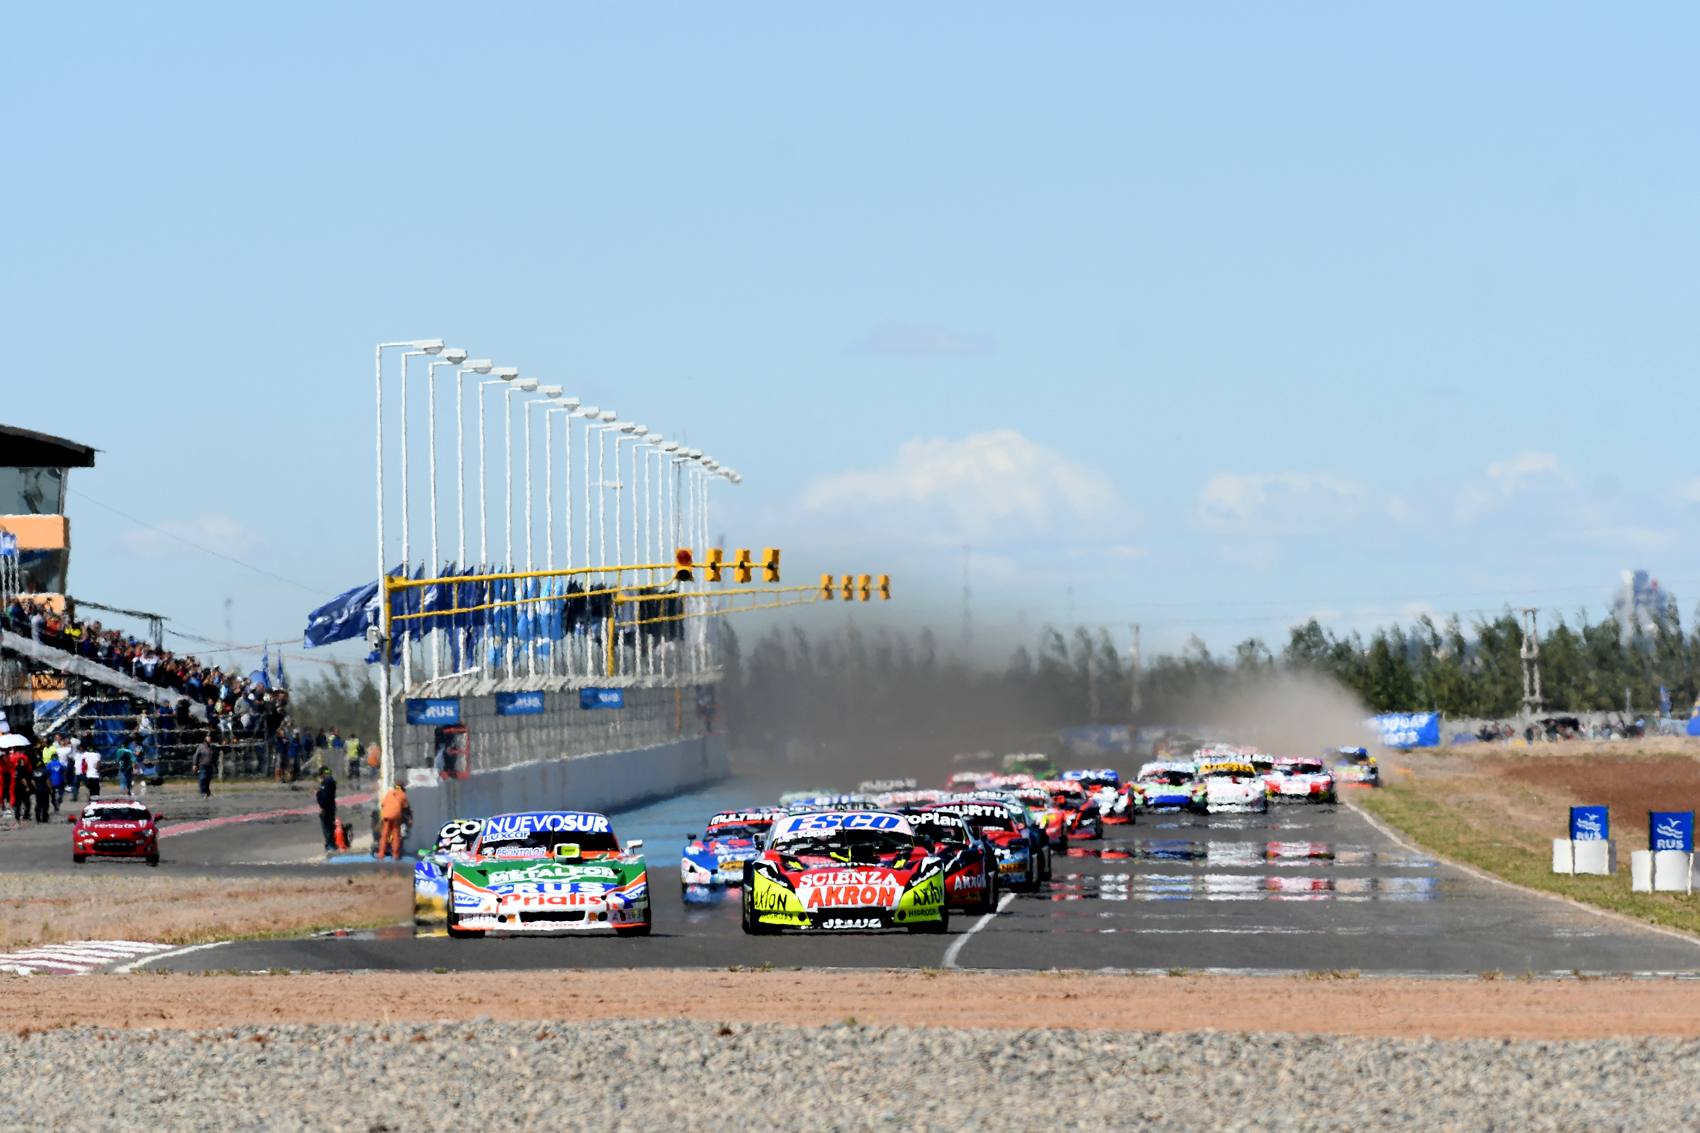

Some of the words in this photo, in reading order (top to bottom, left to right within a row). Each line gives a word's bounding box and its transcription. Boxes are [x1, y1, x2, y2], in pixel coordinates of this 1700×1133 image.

[426, 705, 455, 717] RUS
[486, 814, 608, 834] NUEVOSUR
[1576, 831, 1602, 840] RUS
[1656, 839, 1684, 850] RUS
[799, 870, 899, 888] SCIENZA
[514, 881, 606, 893] RUS
[807, 886, 896, 909] AKRON
